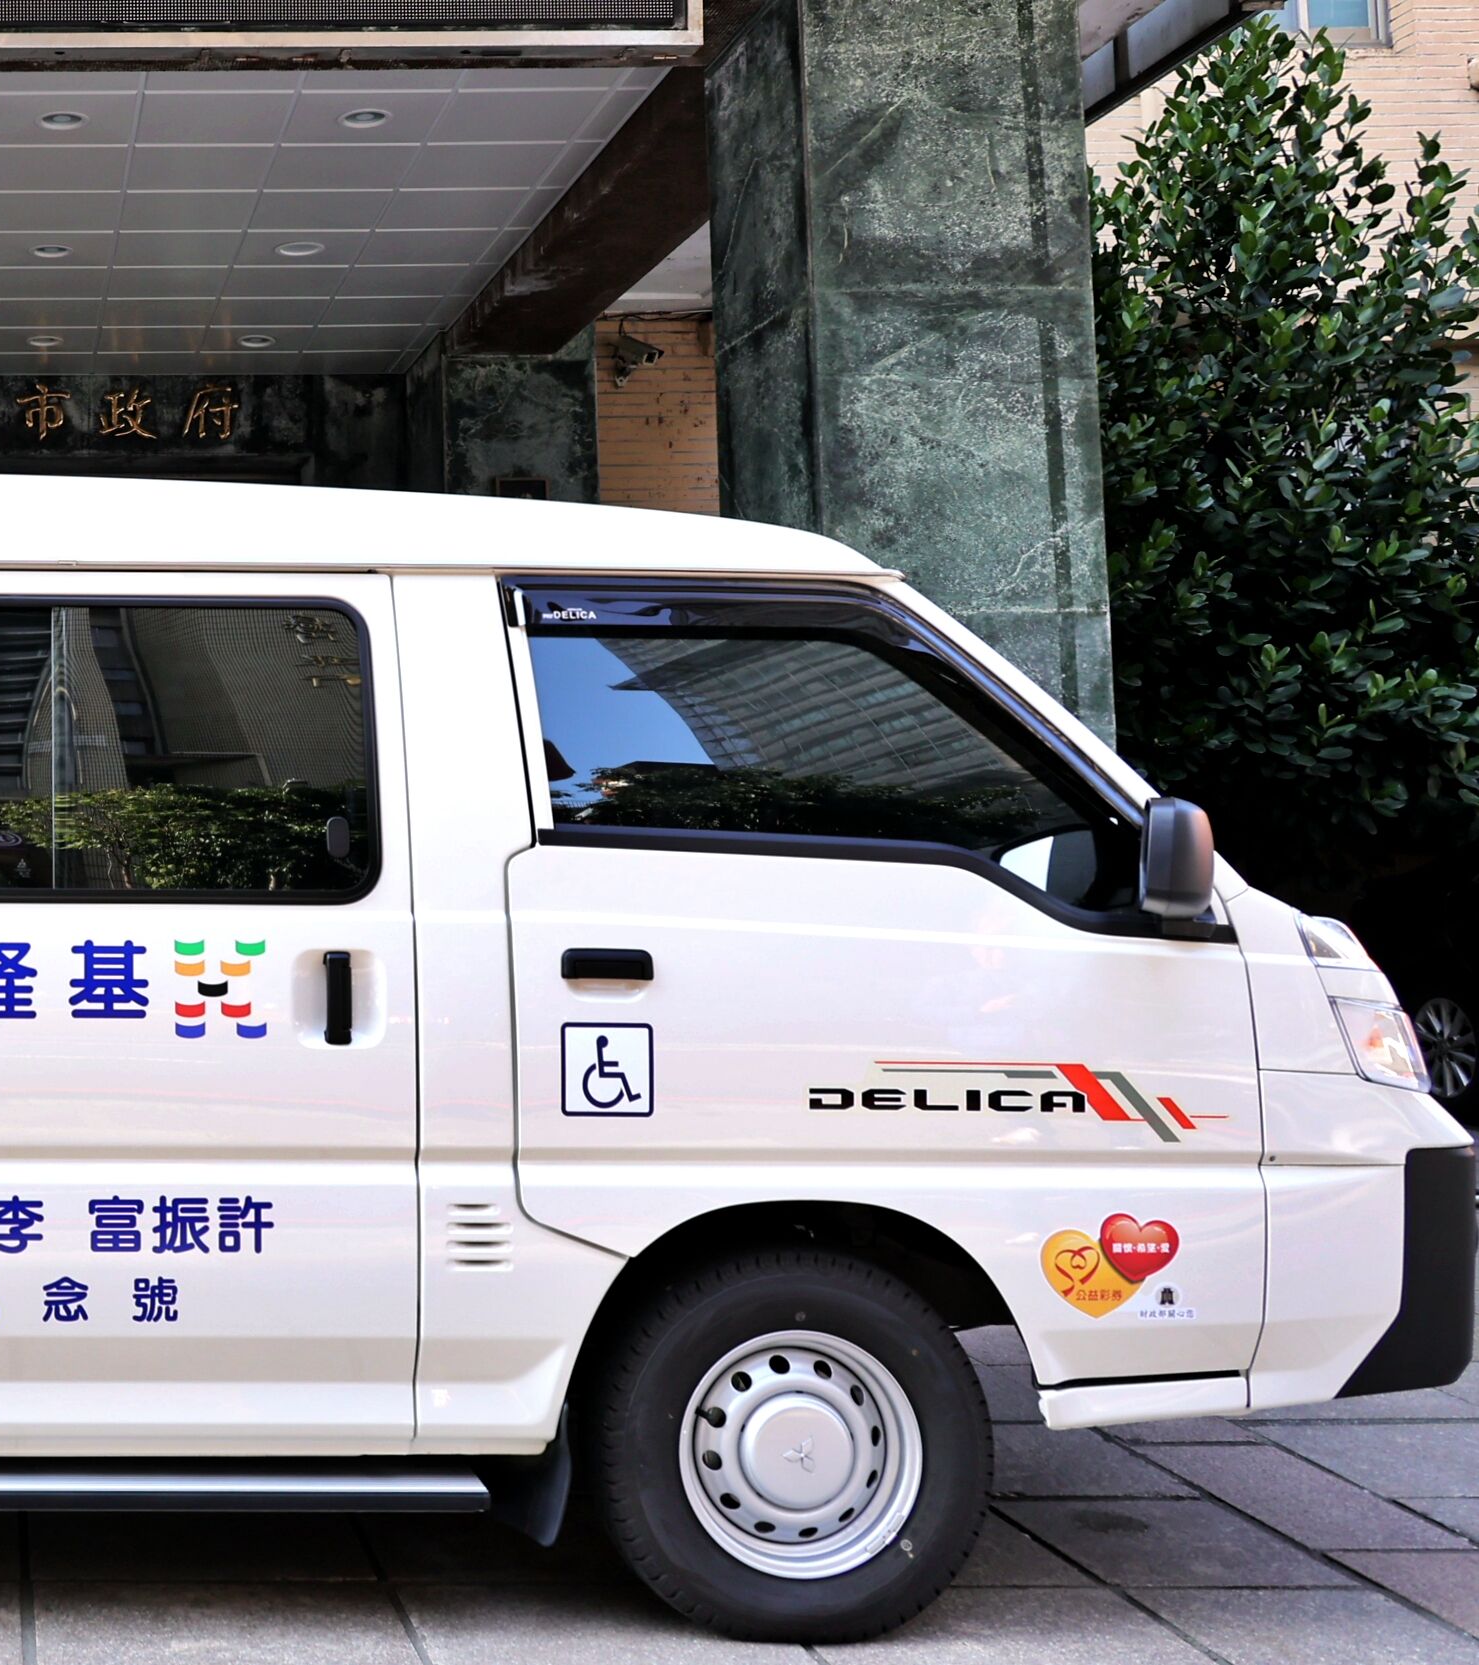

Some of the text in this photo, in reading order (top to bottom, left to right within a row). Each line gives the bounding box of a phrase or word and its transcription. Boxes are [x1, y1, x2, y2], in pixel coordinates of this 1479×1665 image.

[553, 610, 597, 620] DELICA
[808, 1087, 1087, 1113] DELICA
[1075, 1289, 1123, 1302] 公益彩券
